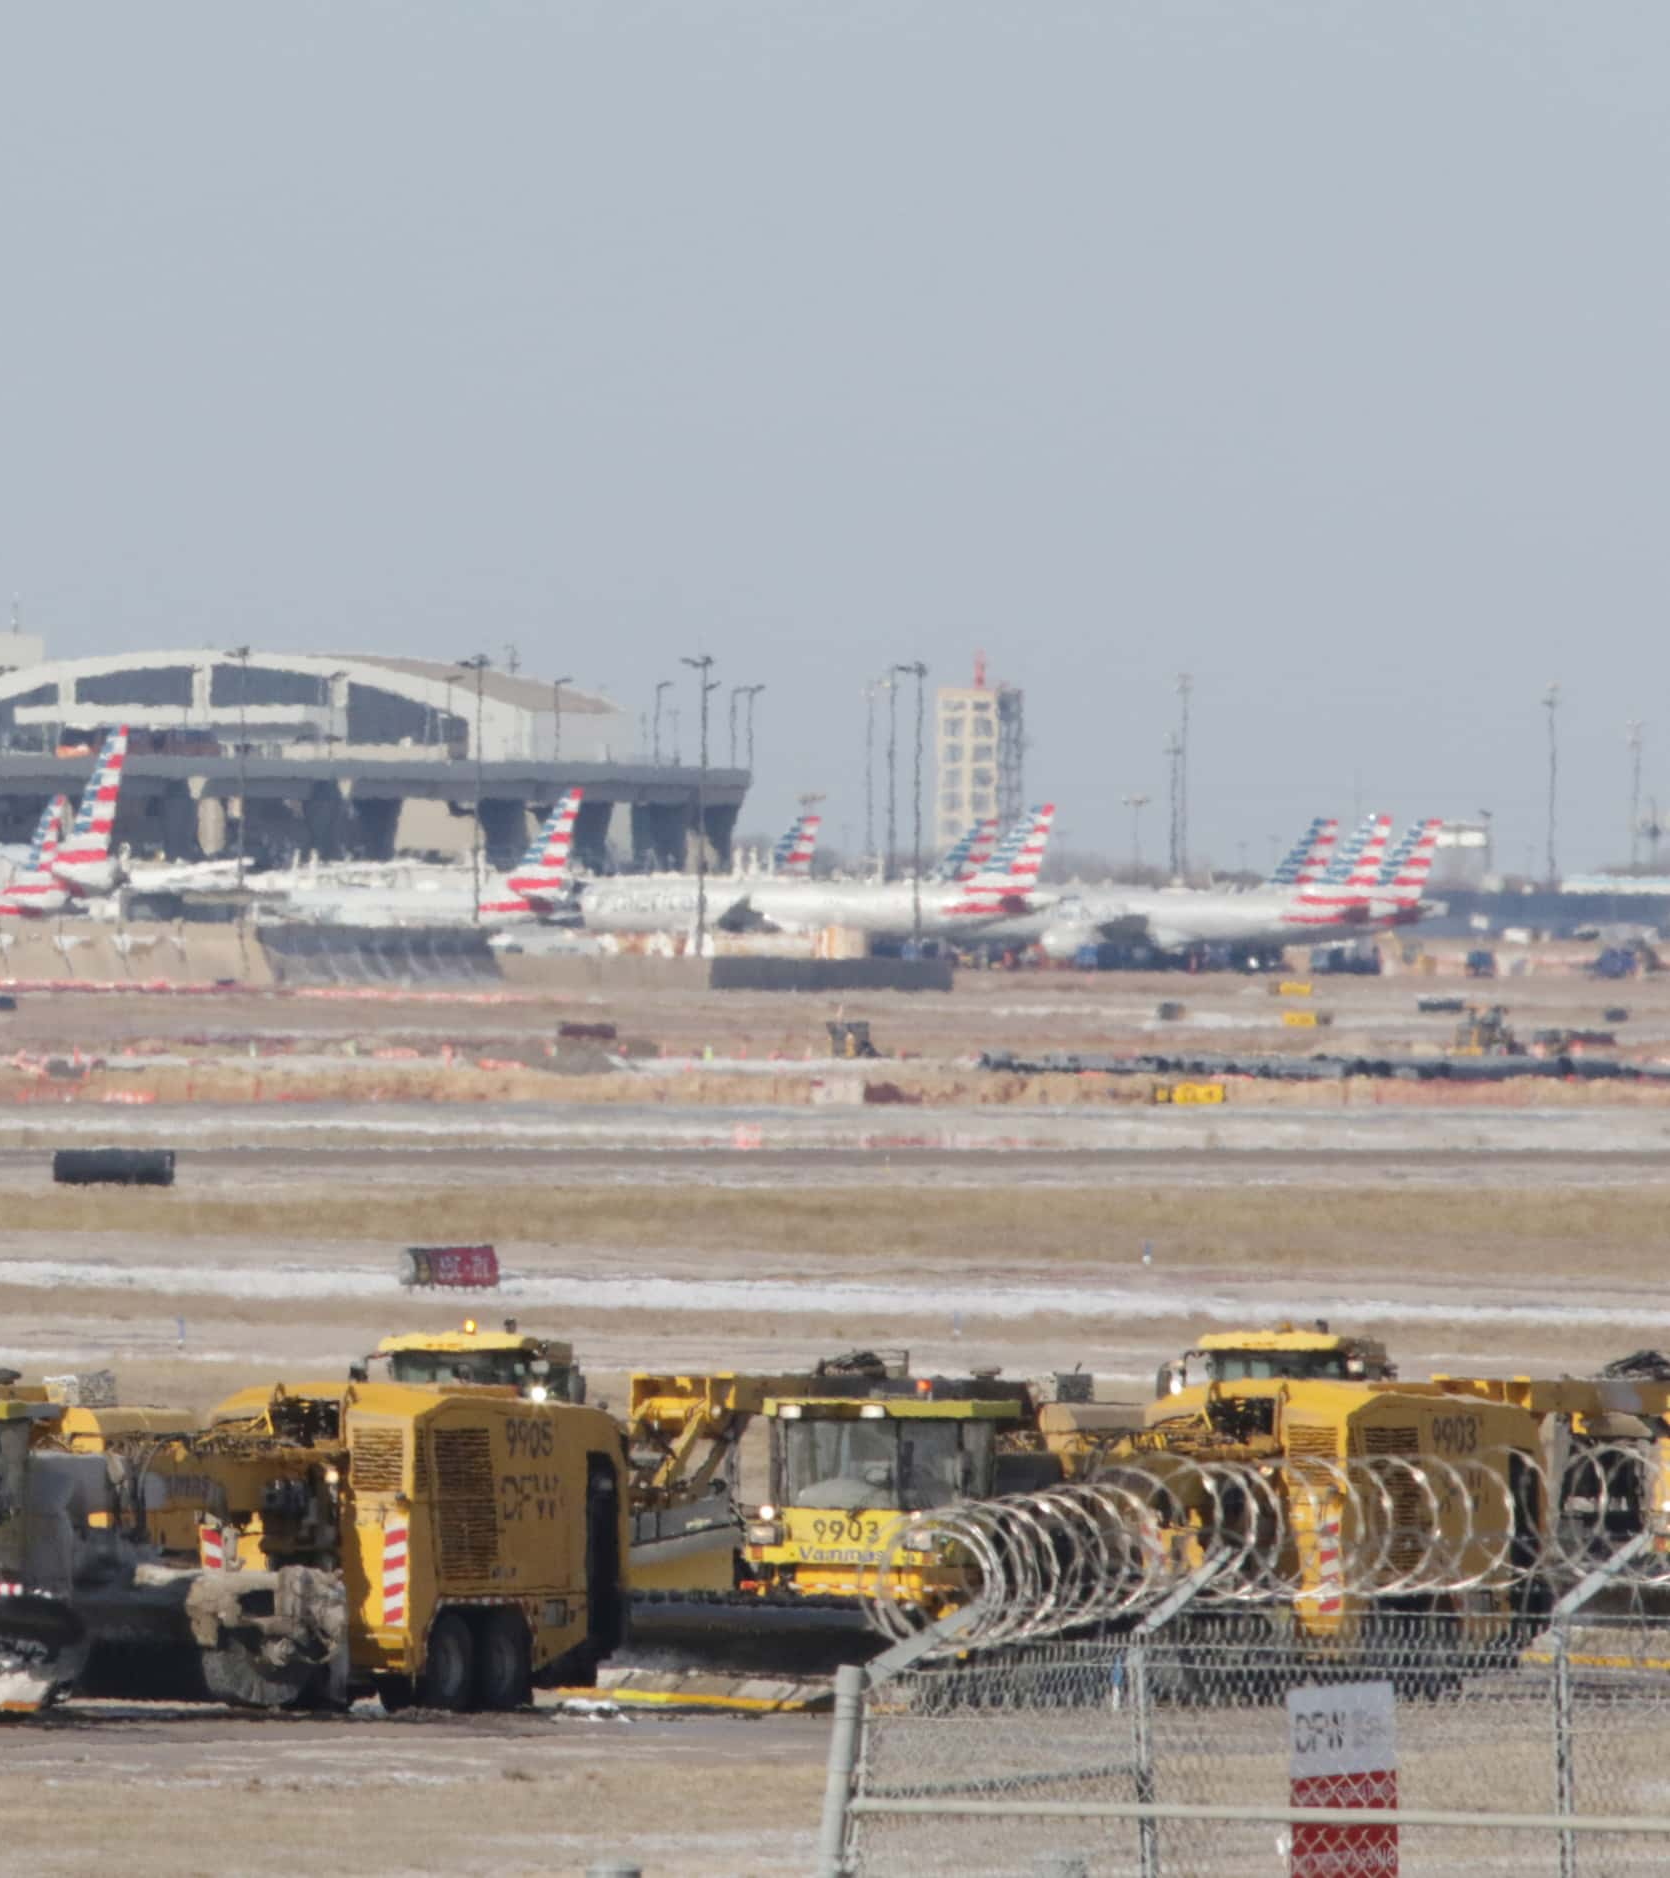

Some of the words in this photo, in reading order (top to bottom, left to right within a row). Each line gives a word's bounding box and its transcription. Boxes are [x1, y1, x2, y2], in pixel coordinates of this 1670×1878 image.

[505, 1418, 553, 1457] 9905
[1433, 1415, 1477, 1455] 9903
[501, 1474, 563, 1520] DFW
[813, 1519, 879, 1544] 9903
